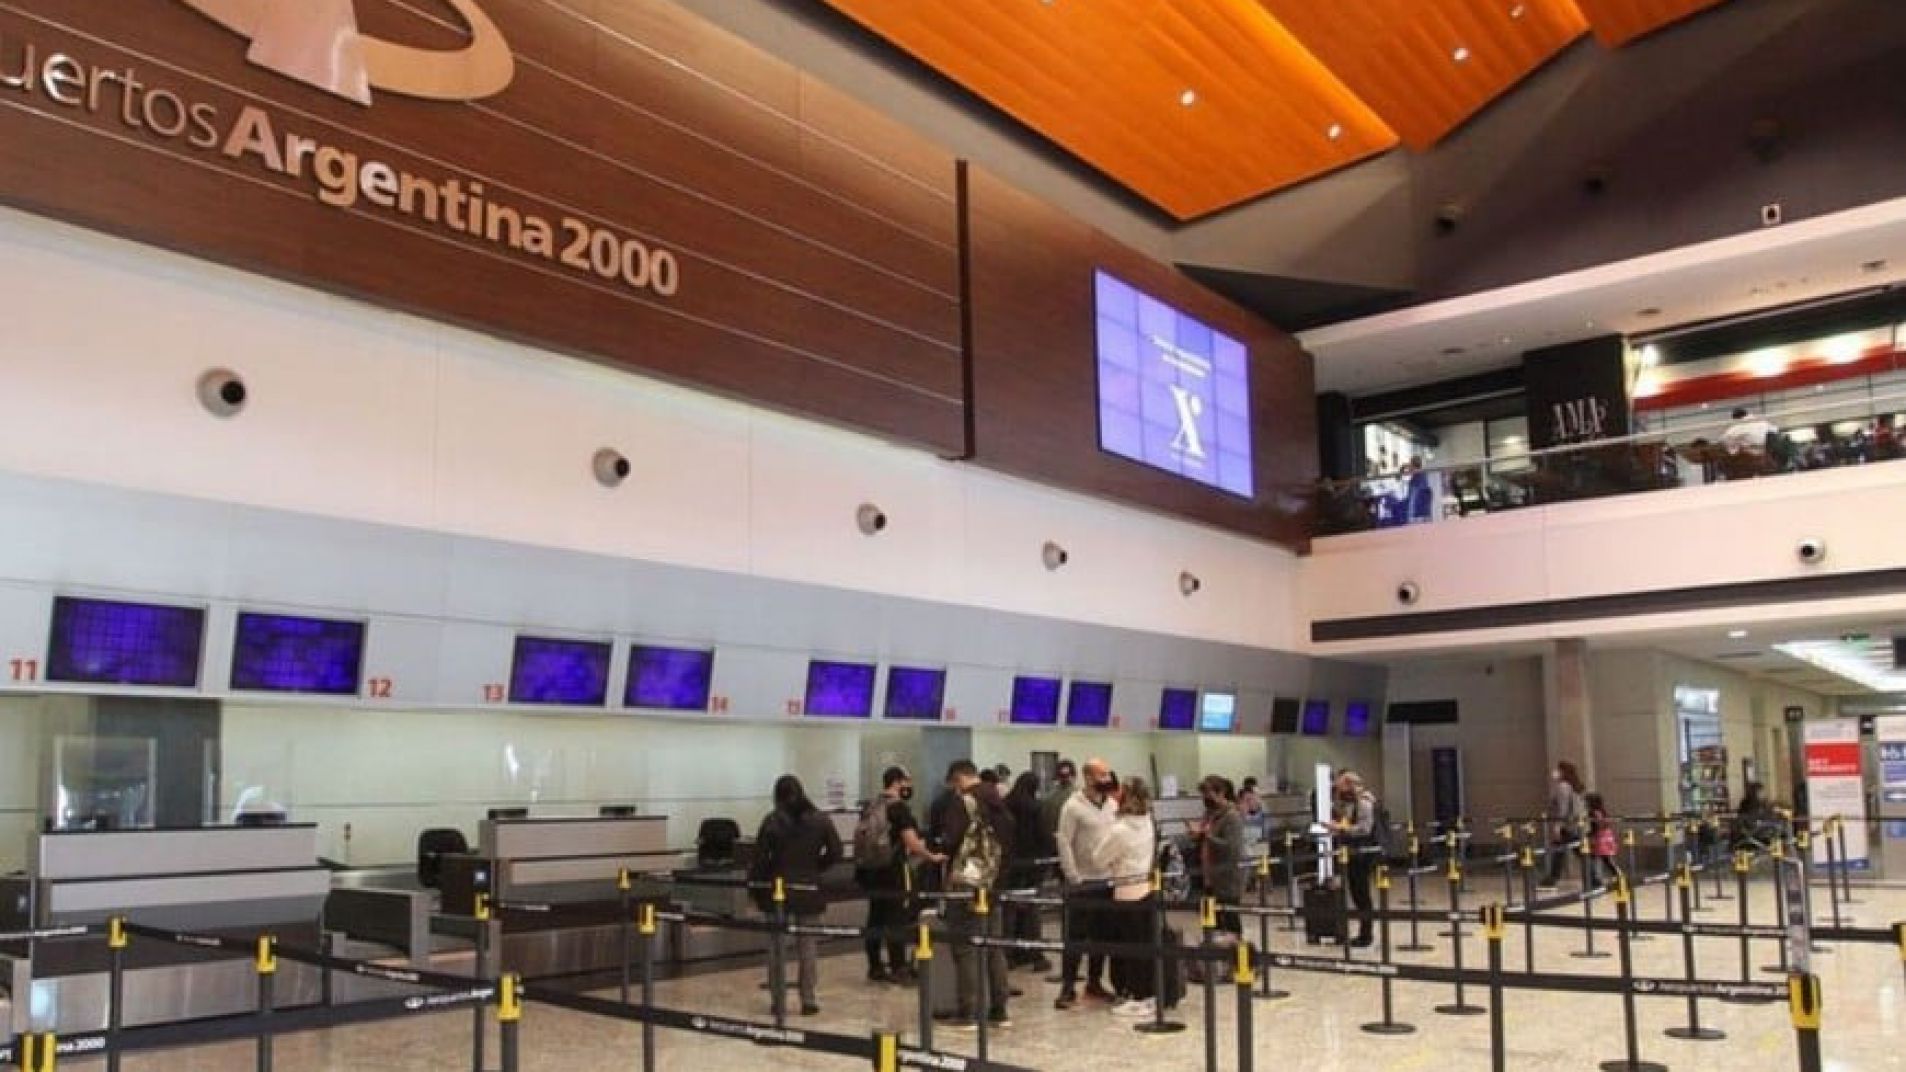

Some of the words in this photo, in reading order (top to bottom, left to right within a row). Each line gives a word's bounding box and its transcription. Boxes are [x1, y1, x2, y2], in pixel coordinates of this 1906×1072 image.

[222, 105, 553, 258] Argentina
[560, 217, 679, 295] 2000
[9, 658, 36, 681] 11
[368, 679, 392, 697] 12
